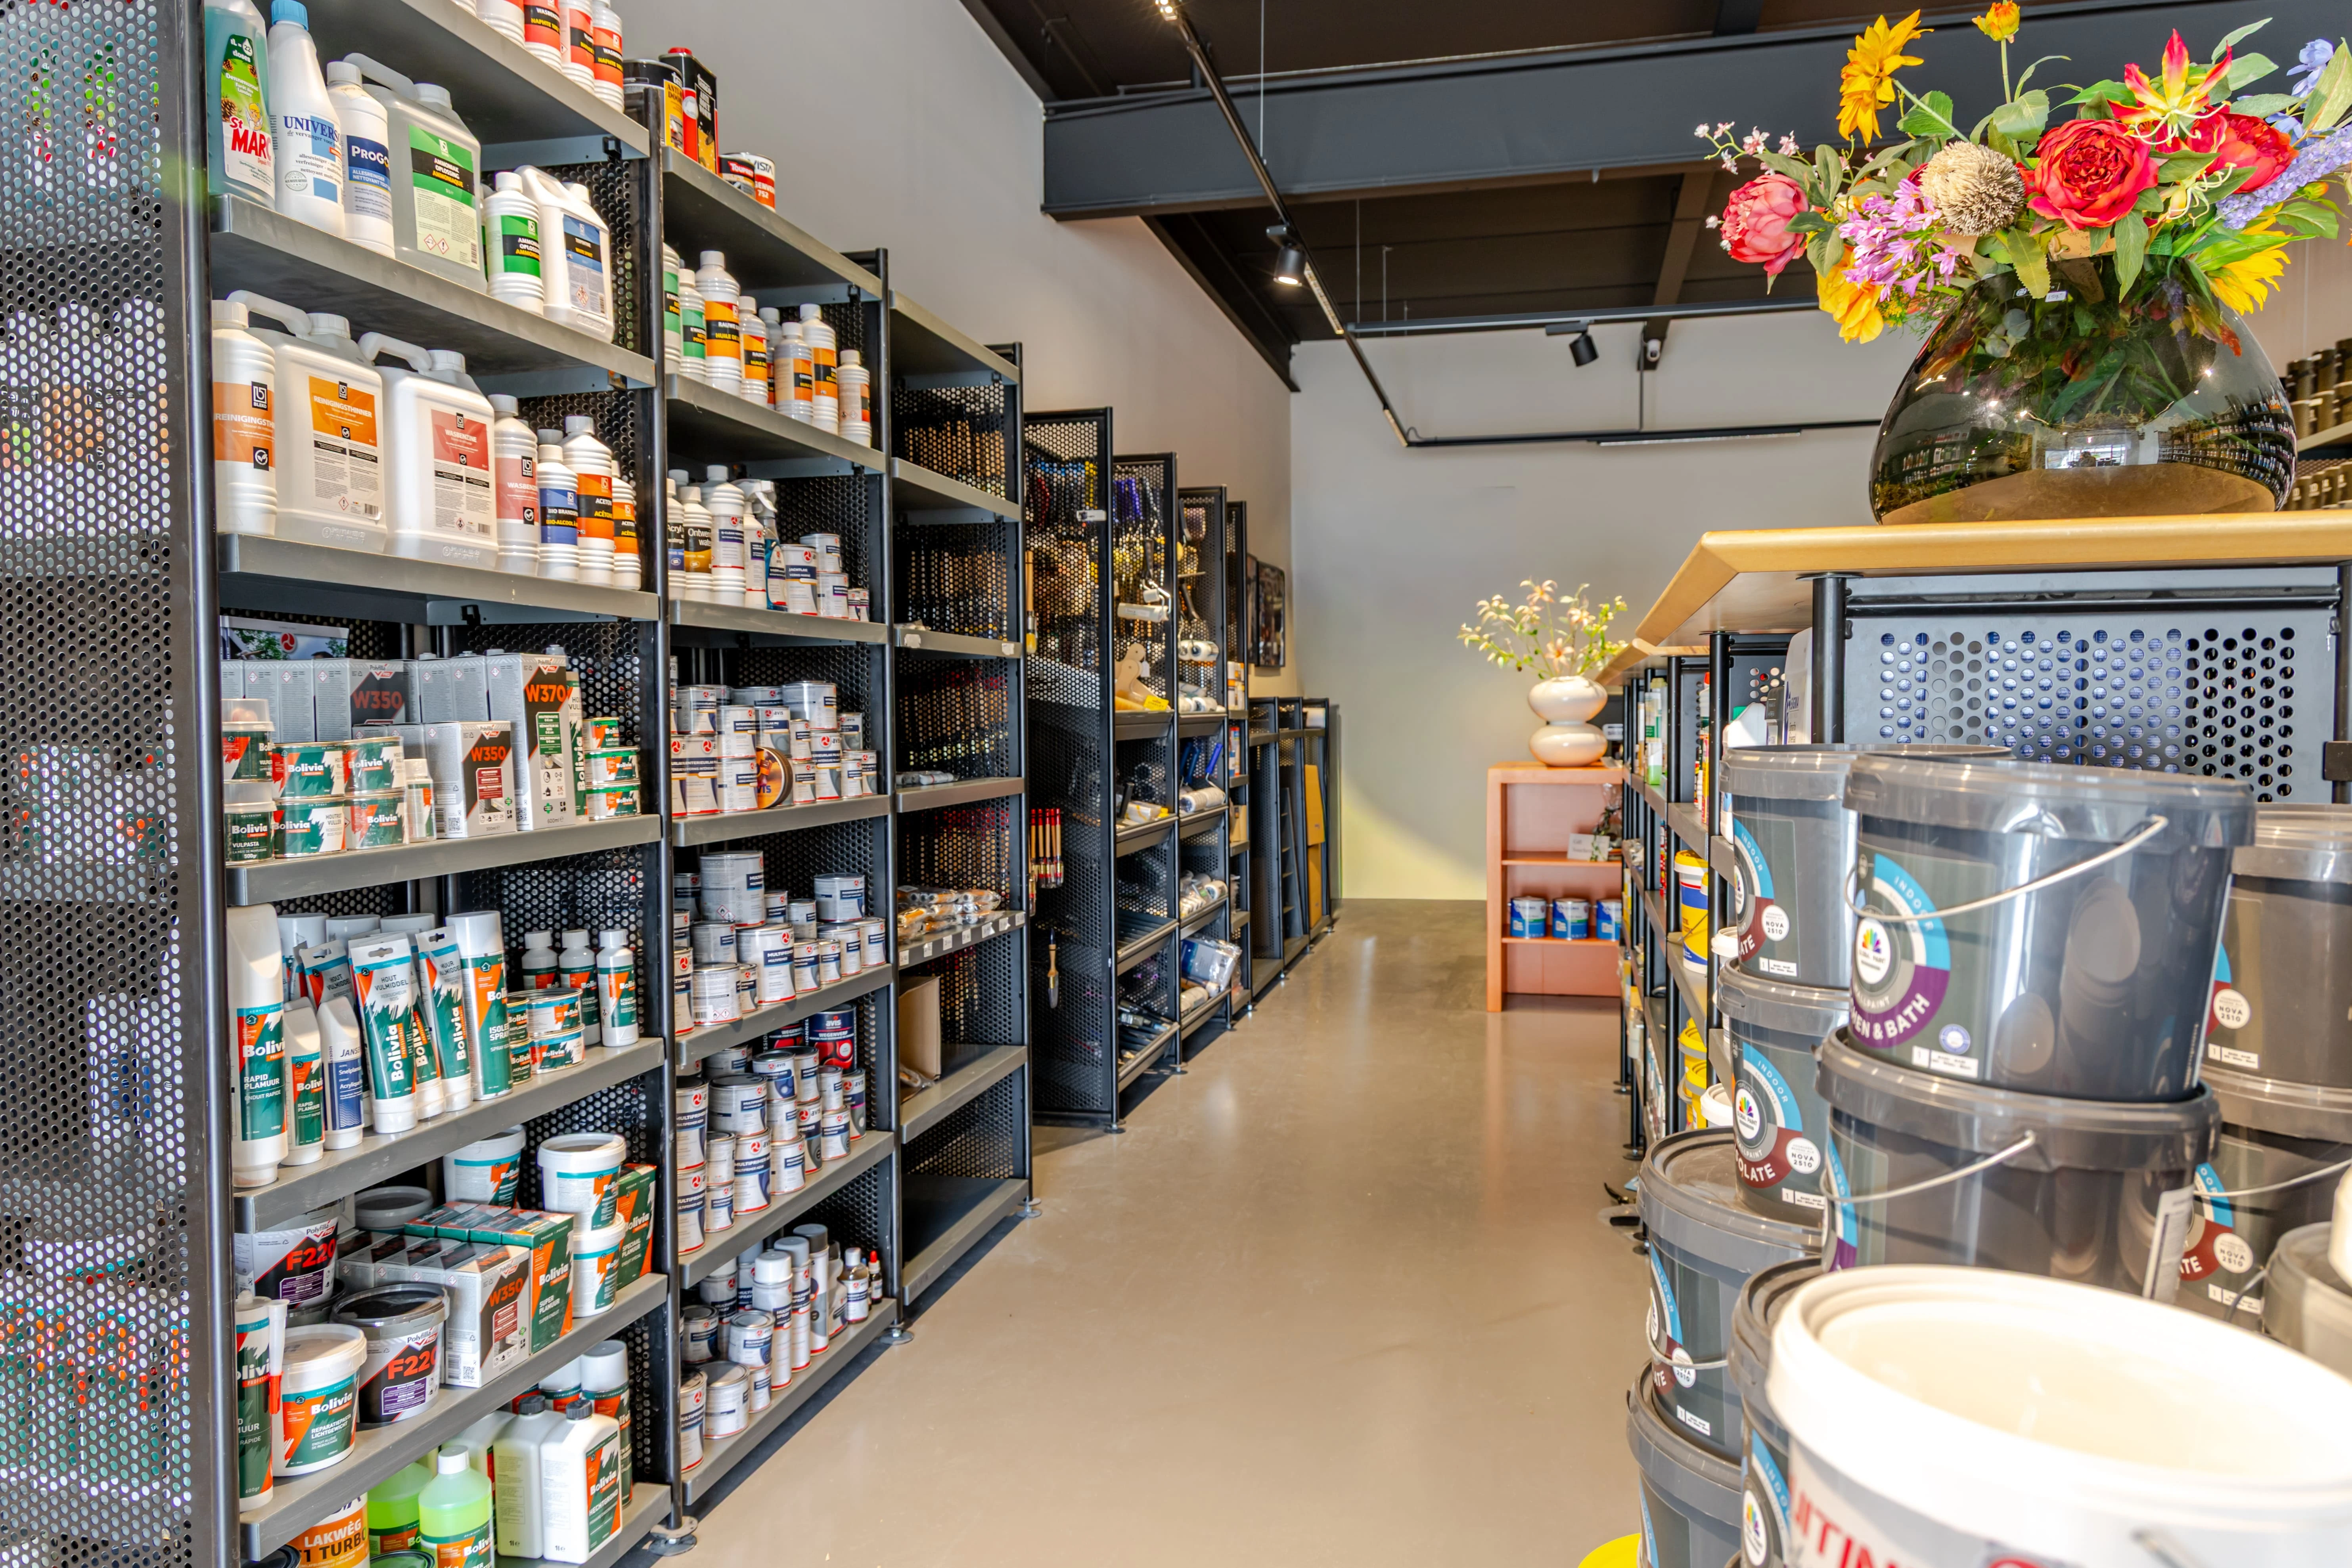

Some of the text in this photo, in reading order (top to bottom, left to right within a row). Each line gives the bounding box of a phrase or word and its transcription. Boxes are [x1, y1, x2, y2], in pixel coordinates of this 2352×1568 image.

[233, 50, 251, 62] doses
[230, 117, 243, 128] St
[231, 128, 272, 159] MARC
[295, 132, 322, 141] vervanger
[295, 160, 324, 168] verfreiniger
[299, 154, 327, 164] allesreiniger
[434, 158, 459, 173] AMMONIAK
[352, 169, 385, 182] ALLESREINIGER
[432, 170, 463, 188] AMMONIAQUE
[435, 165, 460, 179] OPLOSSING
[757, 190, 769, 199] 752
[314, 396, 372, 418] REINIGINGSTHINNER
[445, 429, 477, 443] WASBENZINE
[352, 691, 402, 709] W350
[526, 685, 566, 702] W370
[471, 746, 506, 762] W350
[287, 763, 324, 772] Bolivia
[349, 758, 383, 768] Bolivia
[575, 737, 586, 791] Bolivia
[273, 820, 310, 830] Bolivia
[367, 814, 397, 823] Bolivia
[232, 823, 268, 834] Bolivia
[1741, 833, 1763, 872] INDOOR
[375, 980, 409, 991] VULMIDDEL
[1883, 993, 1930, 1039] BATH
[2219, 1005, 2243, 1016] NOVA
[2221, 1014, 2241, 1022] 2510
[451, 1007, 466, 1061] Bolivia
[385, 1024, 404, 1082] Bolivia
[244, 1074, 268, 1083] RAPID
[244, 1078, 280, 1090] PLAMUUR
[1758, 1059, 1789, 1104] INDOOR
[298, 1104, 320, 1112] PLAMUUR
[1791, 1153, 1814, 1162] NOVA
[306, 1223, 329, 1235] Polyfilla
[286, 1238, 336, 1271] F220
[622, 1244, 640, 1258] PLAMUUR
[2220, 1248, 2246, 1262] NOVA
[2222, 1256, 2243, 1267] 2510
[539, 1263, 569, 1286] Bolivia
[489, 1278, 524, 1308] W350
[539, 1298, 560, 1315] PLAMUUR
[540, 1295, 554, 1308] SUPER
[407, 1330, 431, 1343] Polyfilla
[311, 1392, 352, 1415] Bolivia
[311, 1414, 352, 1434] REPARATIEPASTA
[311, 1421, 349, 1439] LICHTGEWICHT
[590, 1470, 617, 1496] Bolivia
[245, 1486, 260, 1495] 600gr
[589, 1489, 618, 1516] HECHTGROND
[319, 1527, 367, 1560] TURBO
